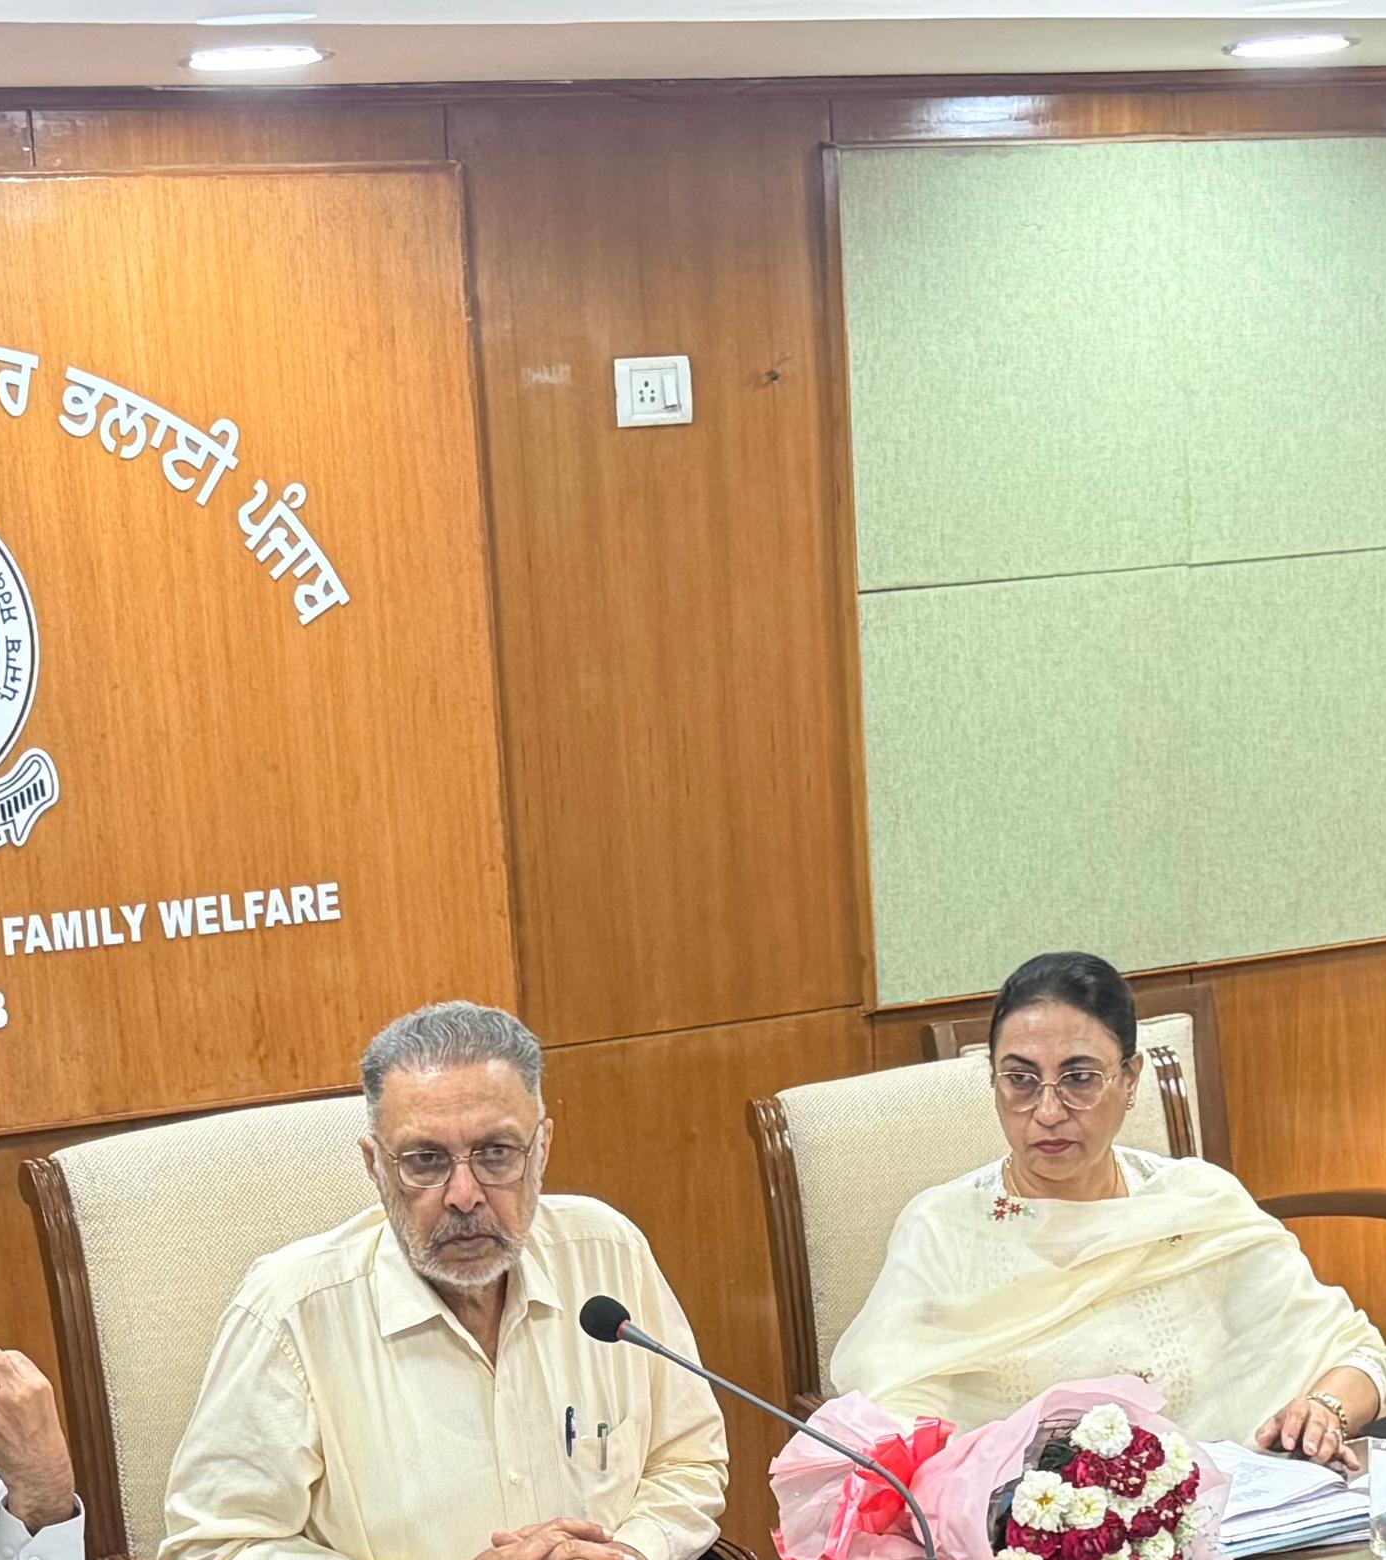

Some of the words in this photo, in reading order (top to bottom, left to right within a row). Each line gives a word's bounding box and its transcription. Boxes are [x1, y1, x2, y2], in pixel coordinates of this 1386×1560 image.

[58, 365, 240, 507] ਭਲਾਈ
[237, 478, 350, 627] ਪੰਜਾਬ
[1, 902, 146, 956] FAMILY
[157, 882, 341, 937] WELFARE
